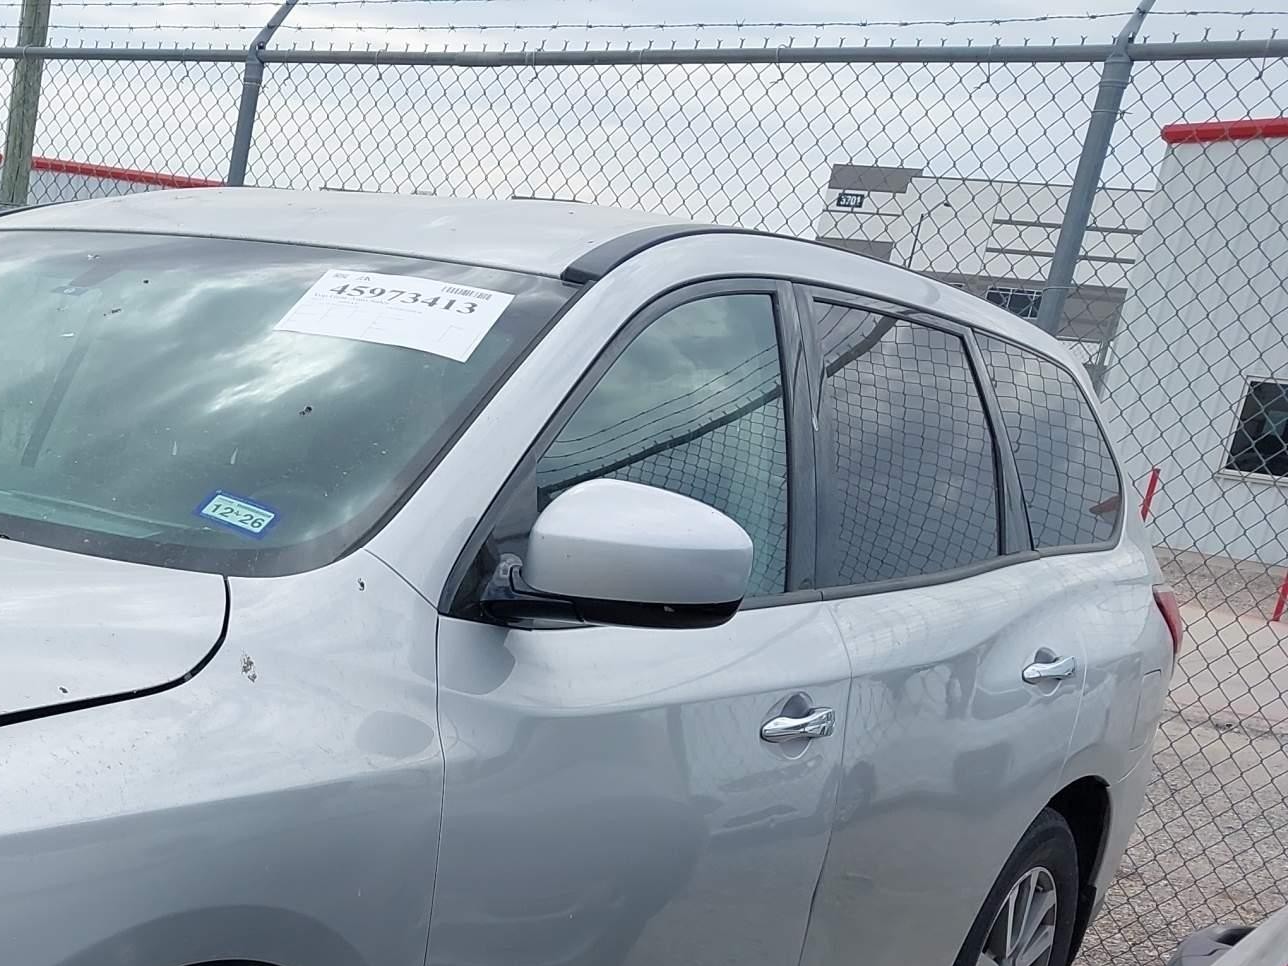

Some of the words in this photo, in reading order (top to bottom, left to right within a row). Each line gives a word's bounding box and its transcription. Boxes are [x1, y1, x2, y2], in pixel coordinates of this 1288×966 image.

[329, 284, 478, 315] 45973413
[212, 503, 235, 518] 12
[239, 513, 265, 529] 26
